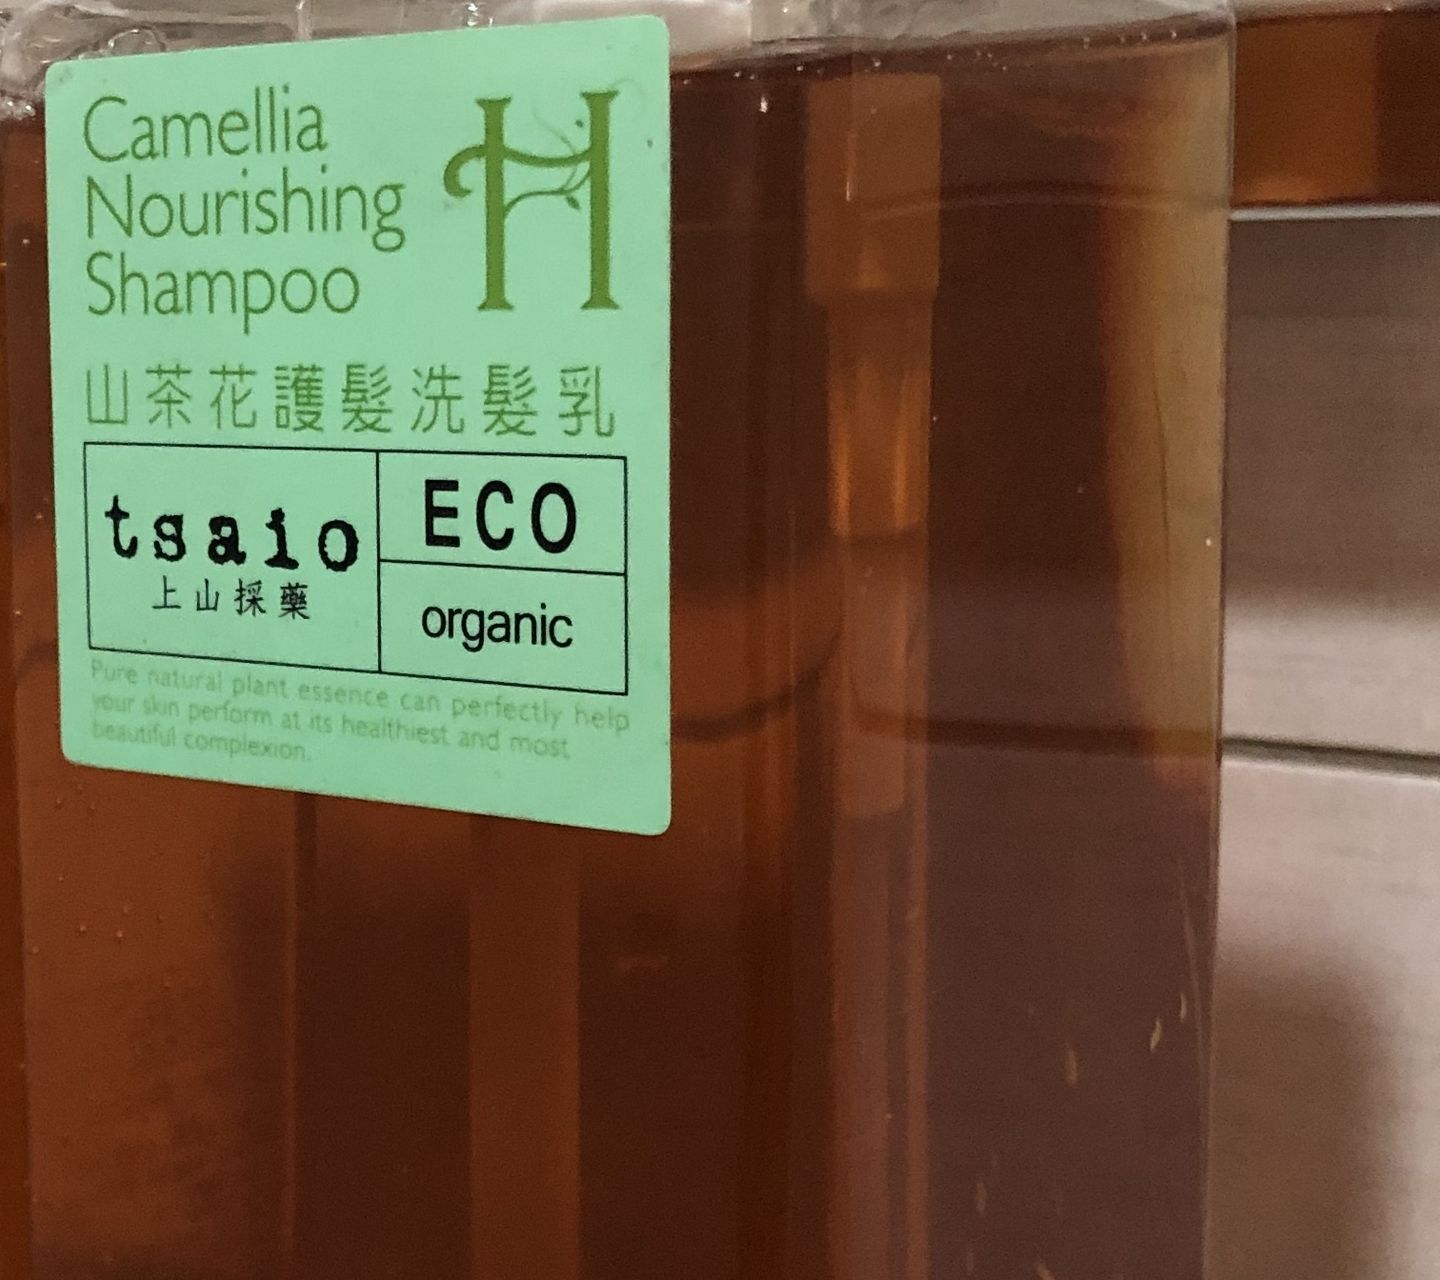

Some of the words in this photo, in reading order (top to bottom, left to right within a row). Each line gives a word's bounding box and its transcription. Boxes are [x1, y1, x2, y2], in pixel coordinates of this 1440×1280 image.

[83, 84, 327, 162] Camellia
[87, 167, 406, 253] Nourishing
[87, 251, 360, 335] Shampoo
[85, 362, 615, 439] 山茶花護髮洗髮乳
[104, 494, 360, 572] tsaio
[424, 478, 577, 554] ECO
[152, 575, 310, 621] 上山採藥
[422, 602, 573, 651] organic
[91, 659, 137, 684] Pure
[148, 668, 222, 692] natural
[233, 673, 287, 698] plant
[298, 683, 388, 708] essence
[401, 693, 440, 712] can
[452, 692, 562, 731] perfectly
[574, 703, 630, 734] help
[189, 699, 272, 727] perform
[281, 710, 301, 730] at
[310, 714, 332, 734] its
[341, 713, 449, 746] healthiest
[459, 729, 500, 752] and
[510, 735, 571, 760] most
[183, 731, 311, 762] complexion.
